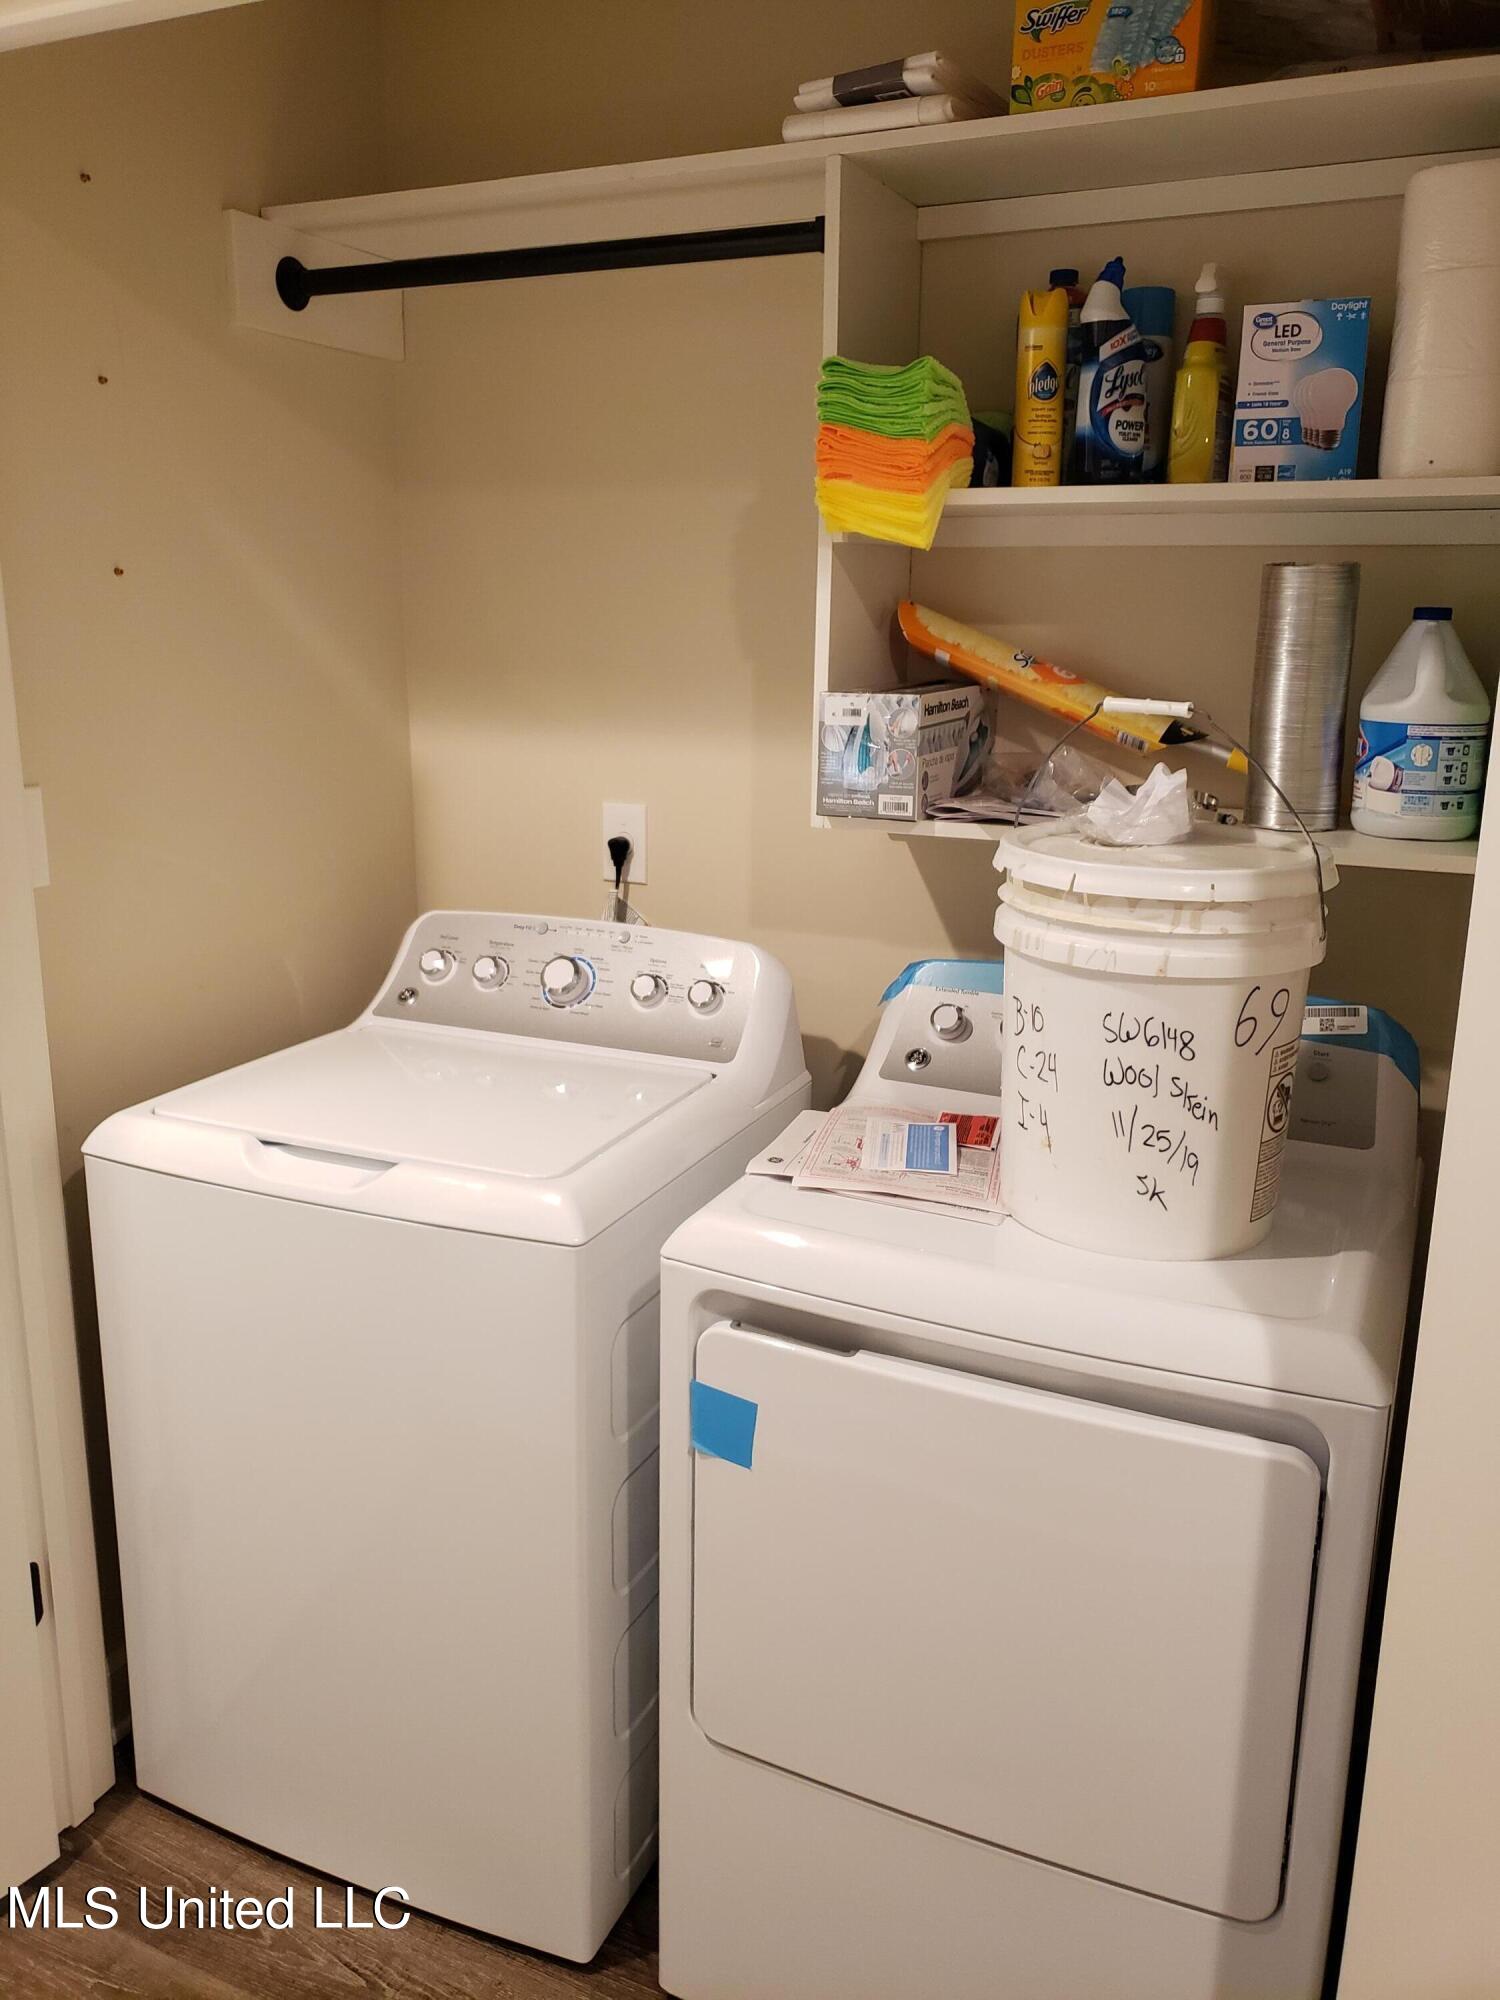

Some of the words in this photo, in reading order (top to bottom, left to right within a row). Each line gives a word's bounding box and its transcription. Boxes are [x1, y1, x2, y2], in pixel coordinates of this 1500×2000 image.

[1020, 4, 1087, 33] Swiffer
[1022, 42, 1086, 61] DUSTERS
[1036, 79, 1064, 99] Gain
[1331, 300, 1368, 311] Daylight
[1274, 324, 1302, 338] LED
[1263, 339, 1286, 347] General
[1287, 338, 1311, 347] Purpose
[1104, 365, 1144, 399] Lysol
[1115, 419, 1144, 432] POWER
[1243, 419, 1278, 441] 60
[1282, 427, 1290, 440] 8
[924, 700, 950, 717] Hamilton
[950, 695, 970, 711] Beach
[823, 797, 853, 805] Hamilton
[1235, 986, 1290, 1056] 69
[1103, 1012, 1195, 1061] SW6148
[1017, 1045, 1058, 1093] C-24
[1112, 1104, 1199, 1187] 11/25/19
